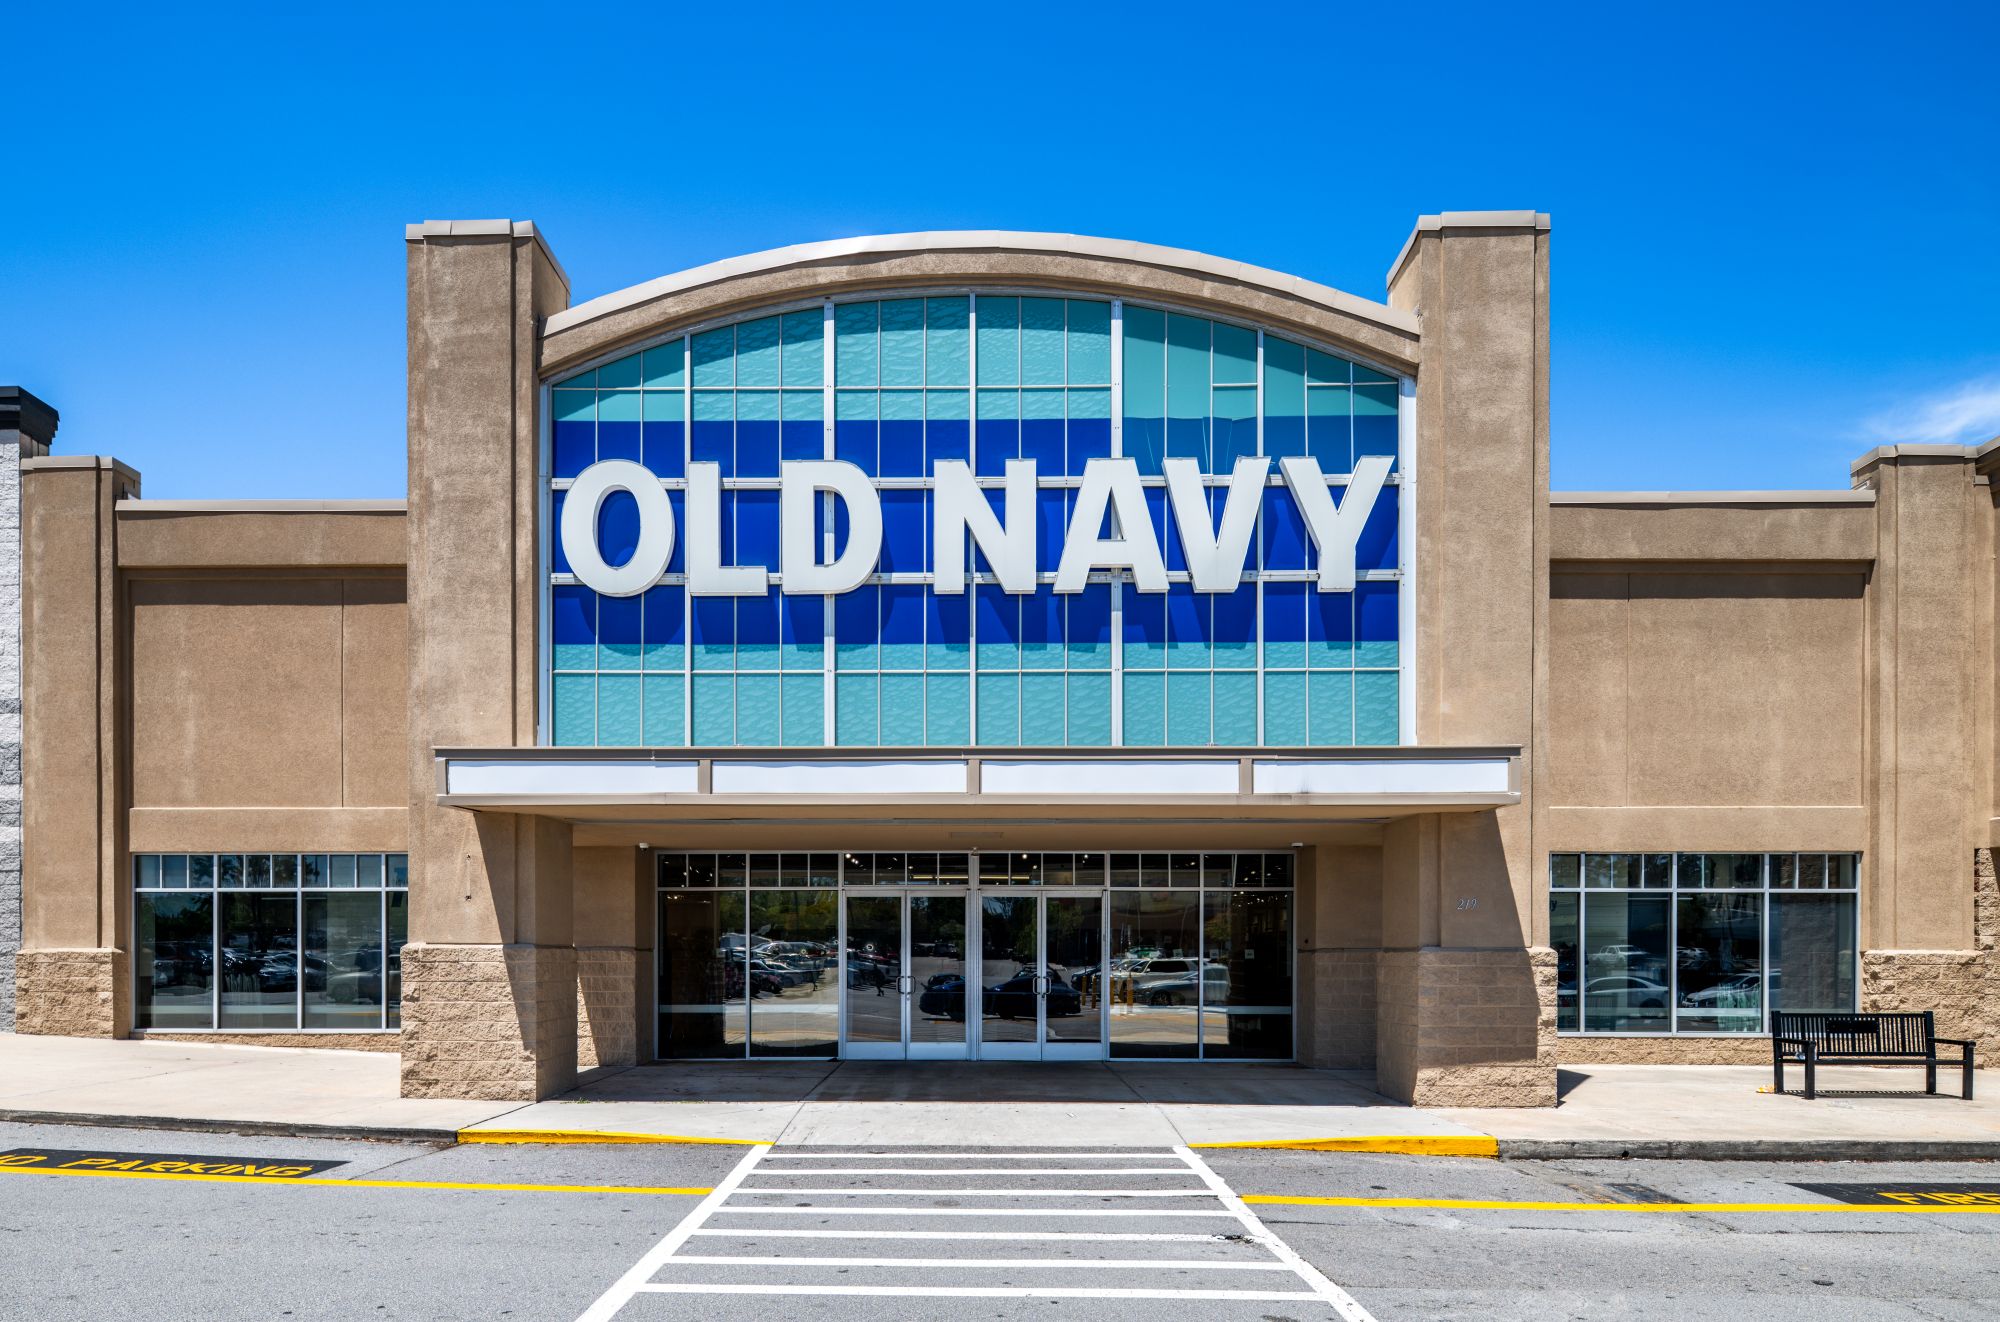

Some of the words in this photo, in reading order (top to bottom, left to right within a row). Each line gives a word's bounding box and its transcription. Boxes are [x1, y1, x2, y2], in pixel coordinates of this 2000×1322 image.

[561, 459, 882, 597] OLD
[933, 455, 1395, 594] NAVY
[0, 1154, 48, 1166] O
[57, 1158, 313, 1176] PARKING
